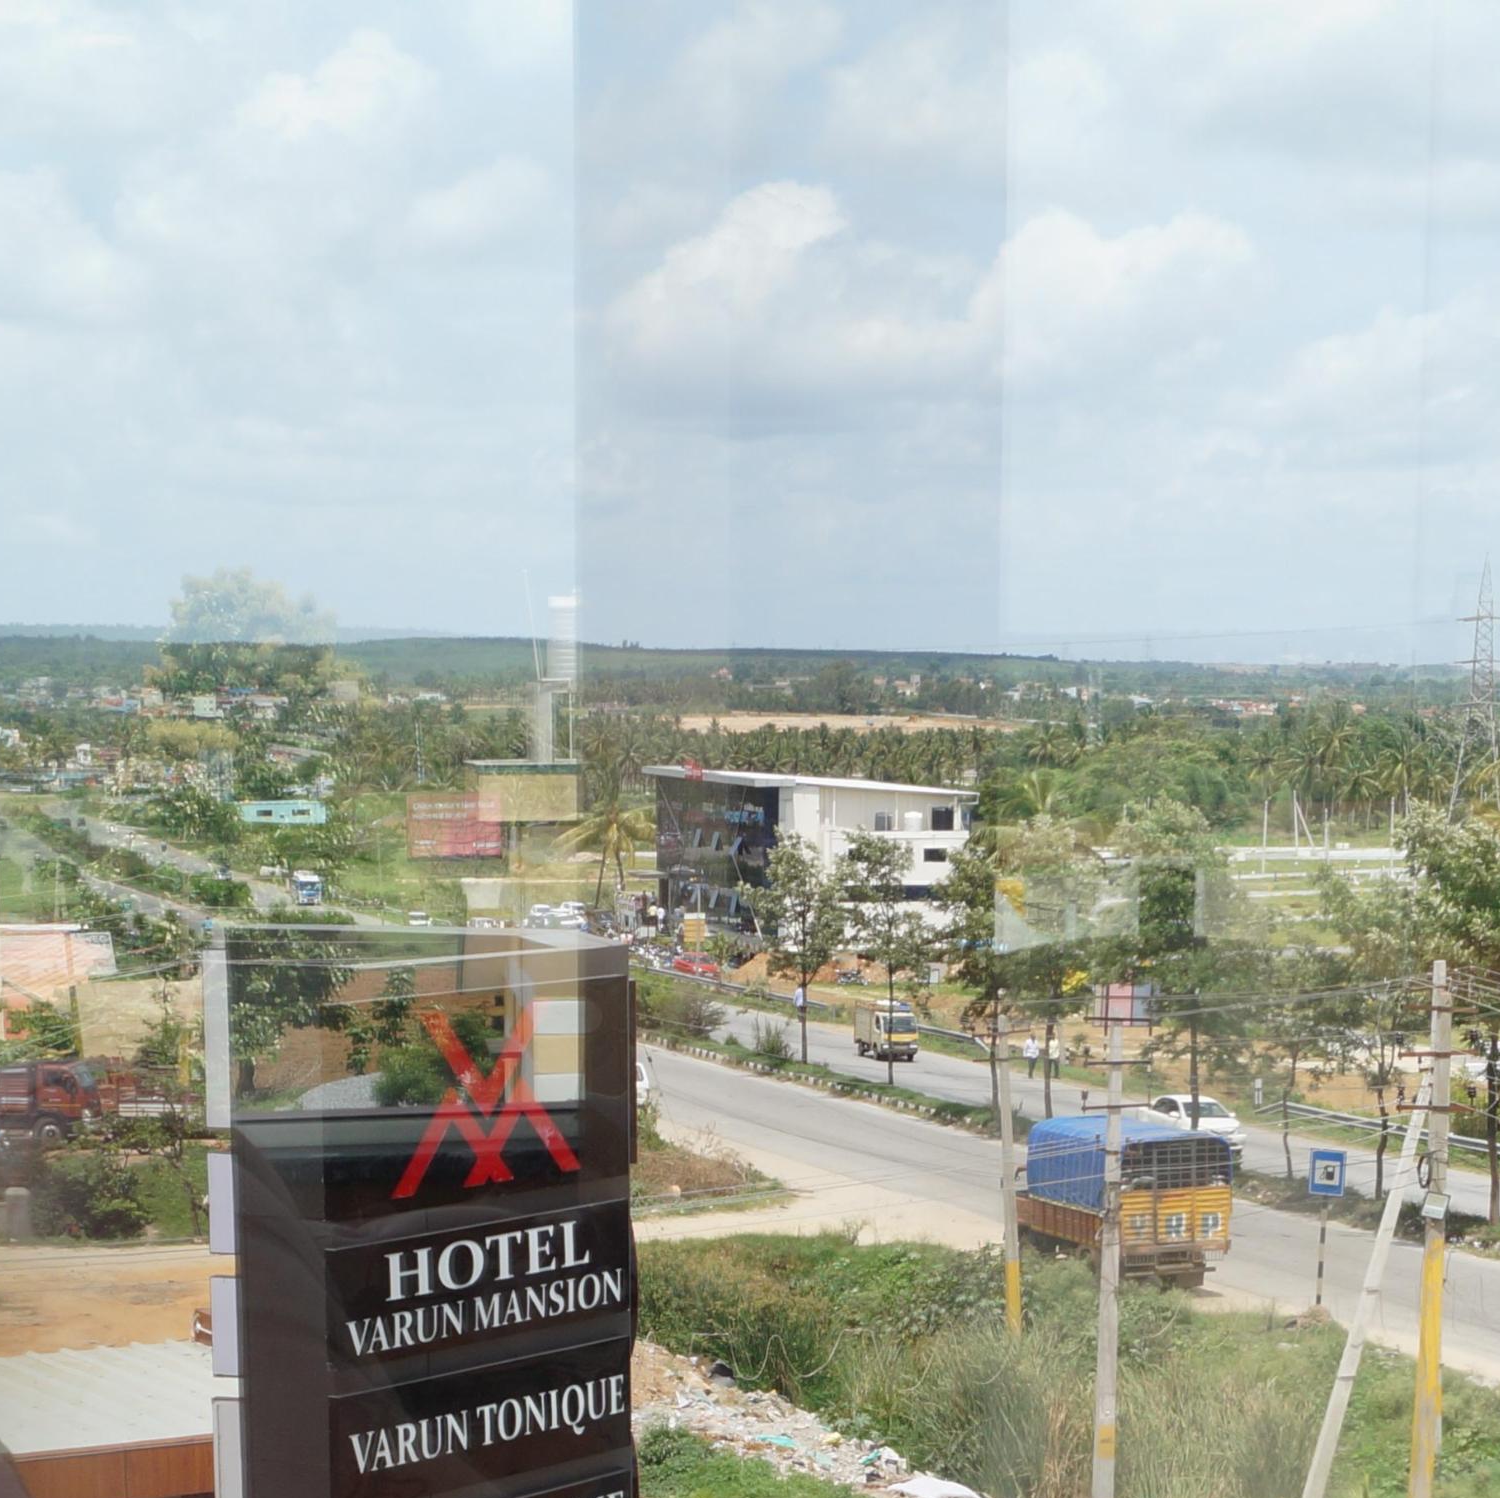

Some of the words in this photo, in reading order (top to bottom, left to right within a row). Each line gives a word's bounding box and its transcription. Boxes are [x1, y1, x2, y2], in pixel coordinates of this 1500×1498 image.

[385, 1220, 590, 1302] HOTEL
[345, 1300, 463, 1357] VARUN
[474, 1267, 623, 1331] MANSION
[349, 1411, 468, 1475] VARUN
[476, 1374, 625, 1447] TONIQUE
